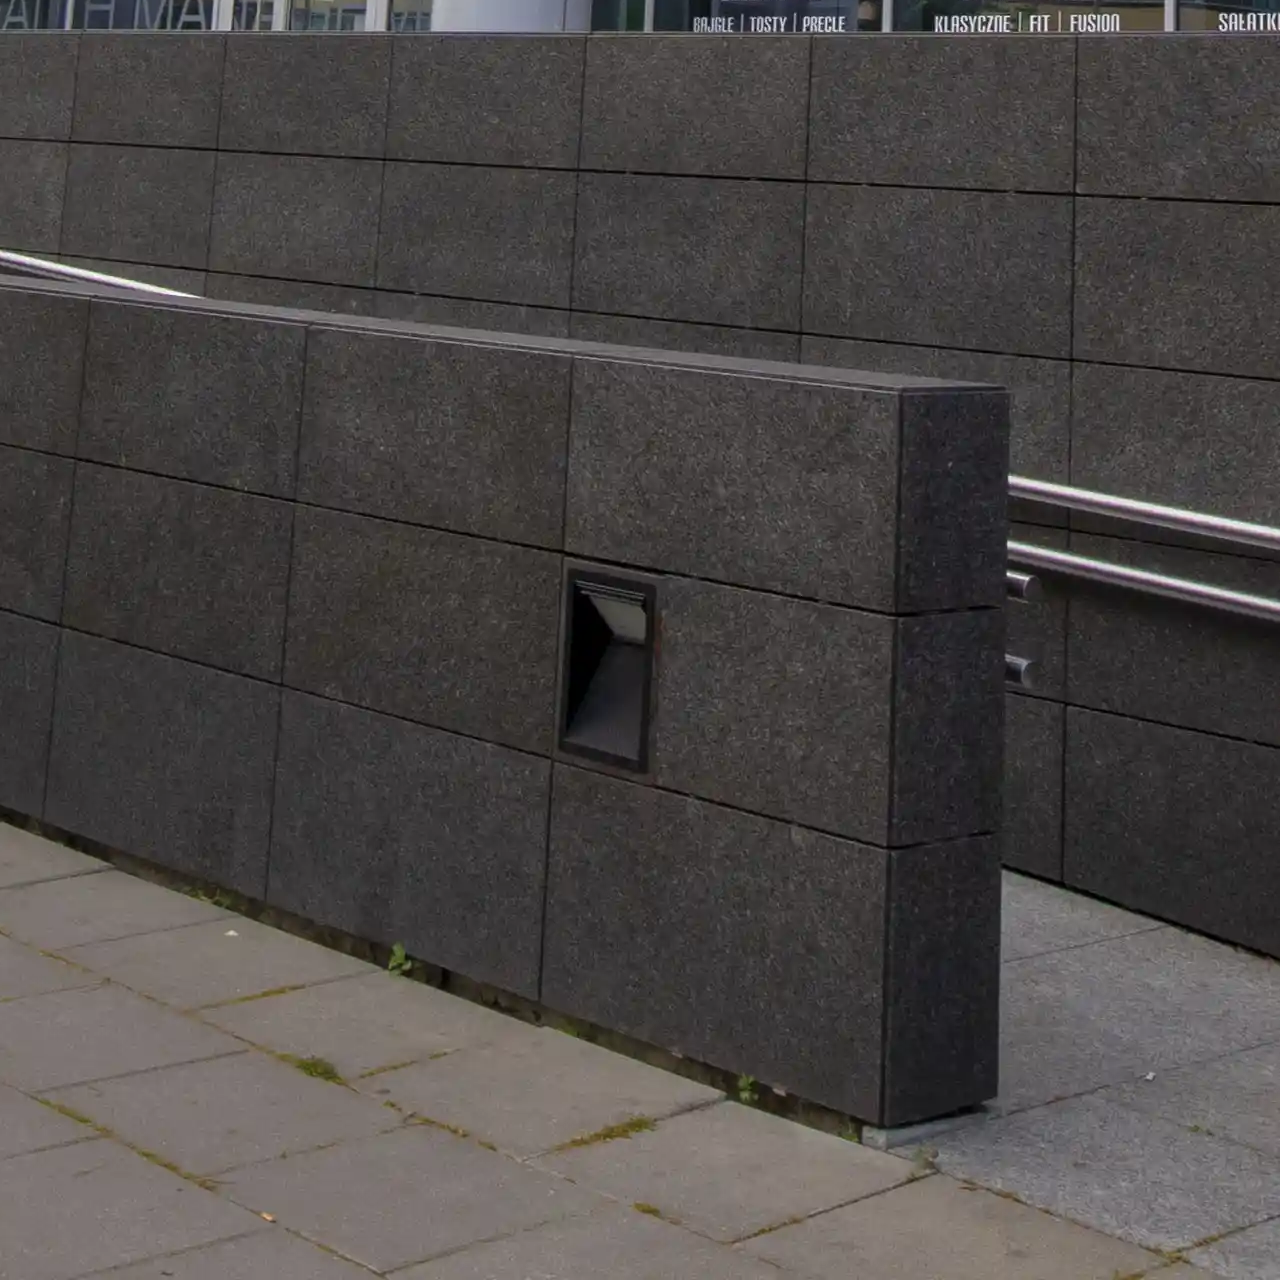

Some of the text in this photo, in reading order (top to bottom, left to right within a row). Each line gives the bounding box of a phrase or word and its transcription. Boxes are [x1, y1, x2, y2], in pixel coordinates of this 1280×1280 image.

[749, 15, 788, 33] TOSTY
[933, 13, 1121, 33] KLASYCZNE FIT FUSION
